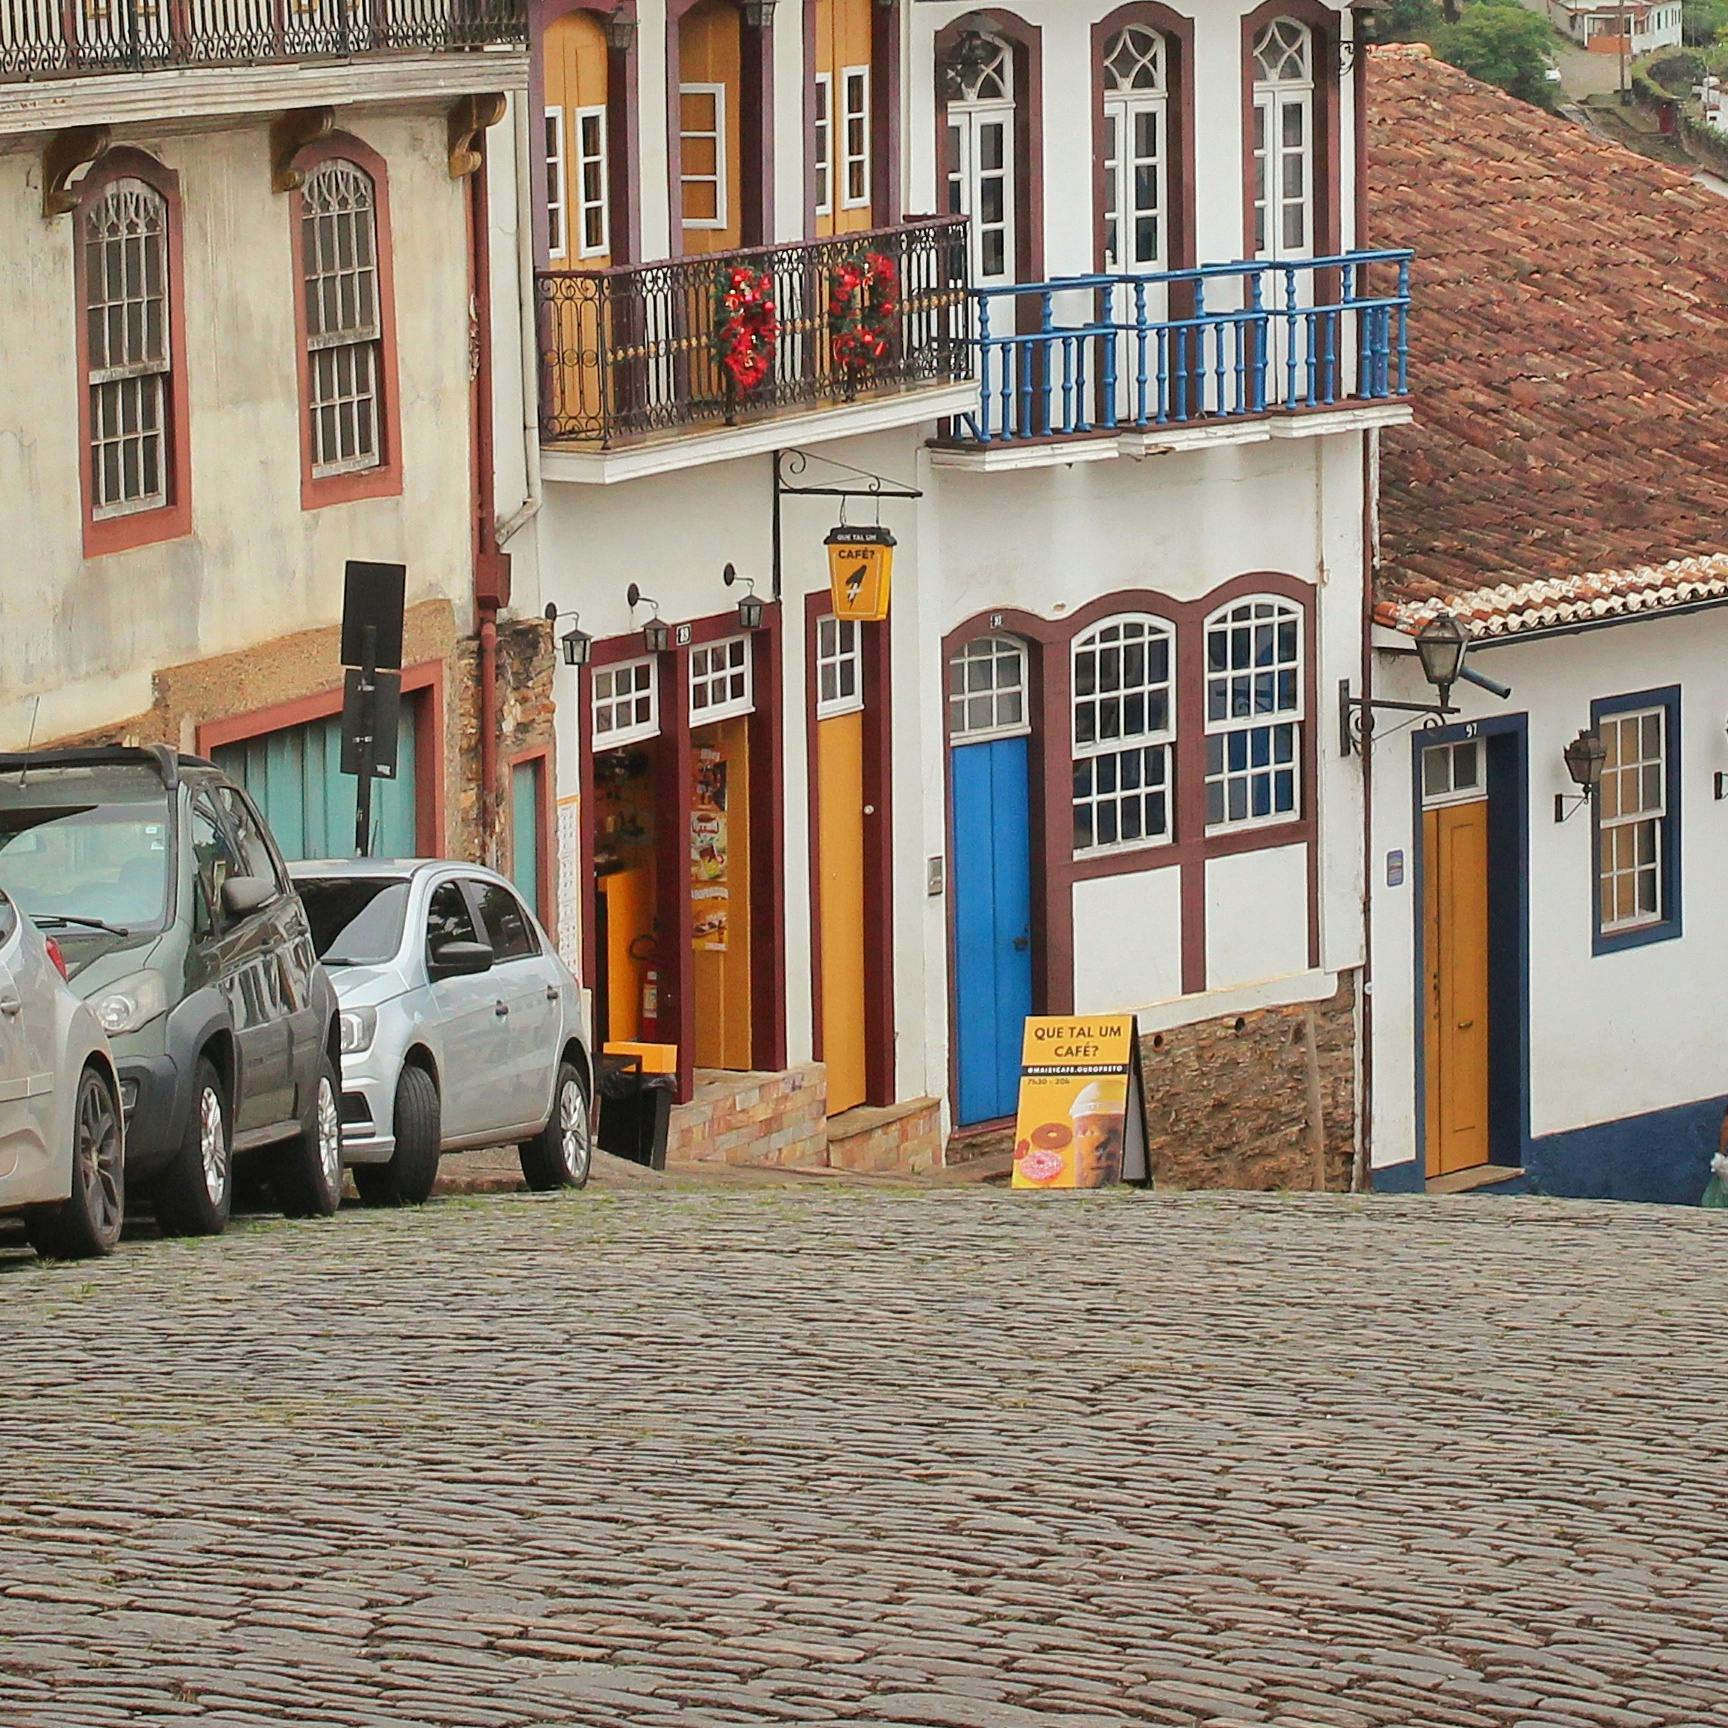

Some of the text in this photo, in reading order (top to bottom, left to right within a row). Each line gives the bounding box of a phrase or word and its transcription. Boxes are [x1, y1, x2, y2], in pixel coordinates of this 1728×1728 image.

[838, 547, 875, 560] CAFÉ?
[1034, 1026, 1121, 1040] QUE TAL UM
[1054, 1041, 1099, 1058] CAFÉ?
